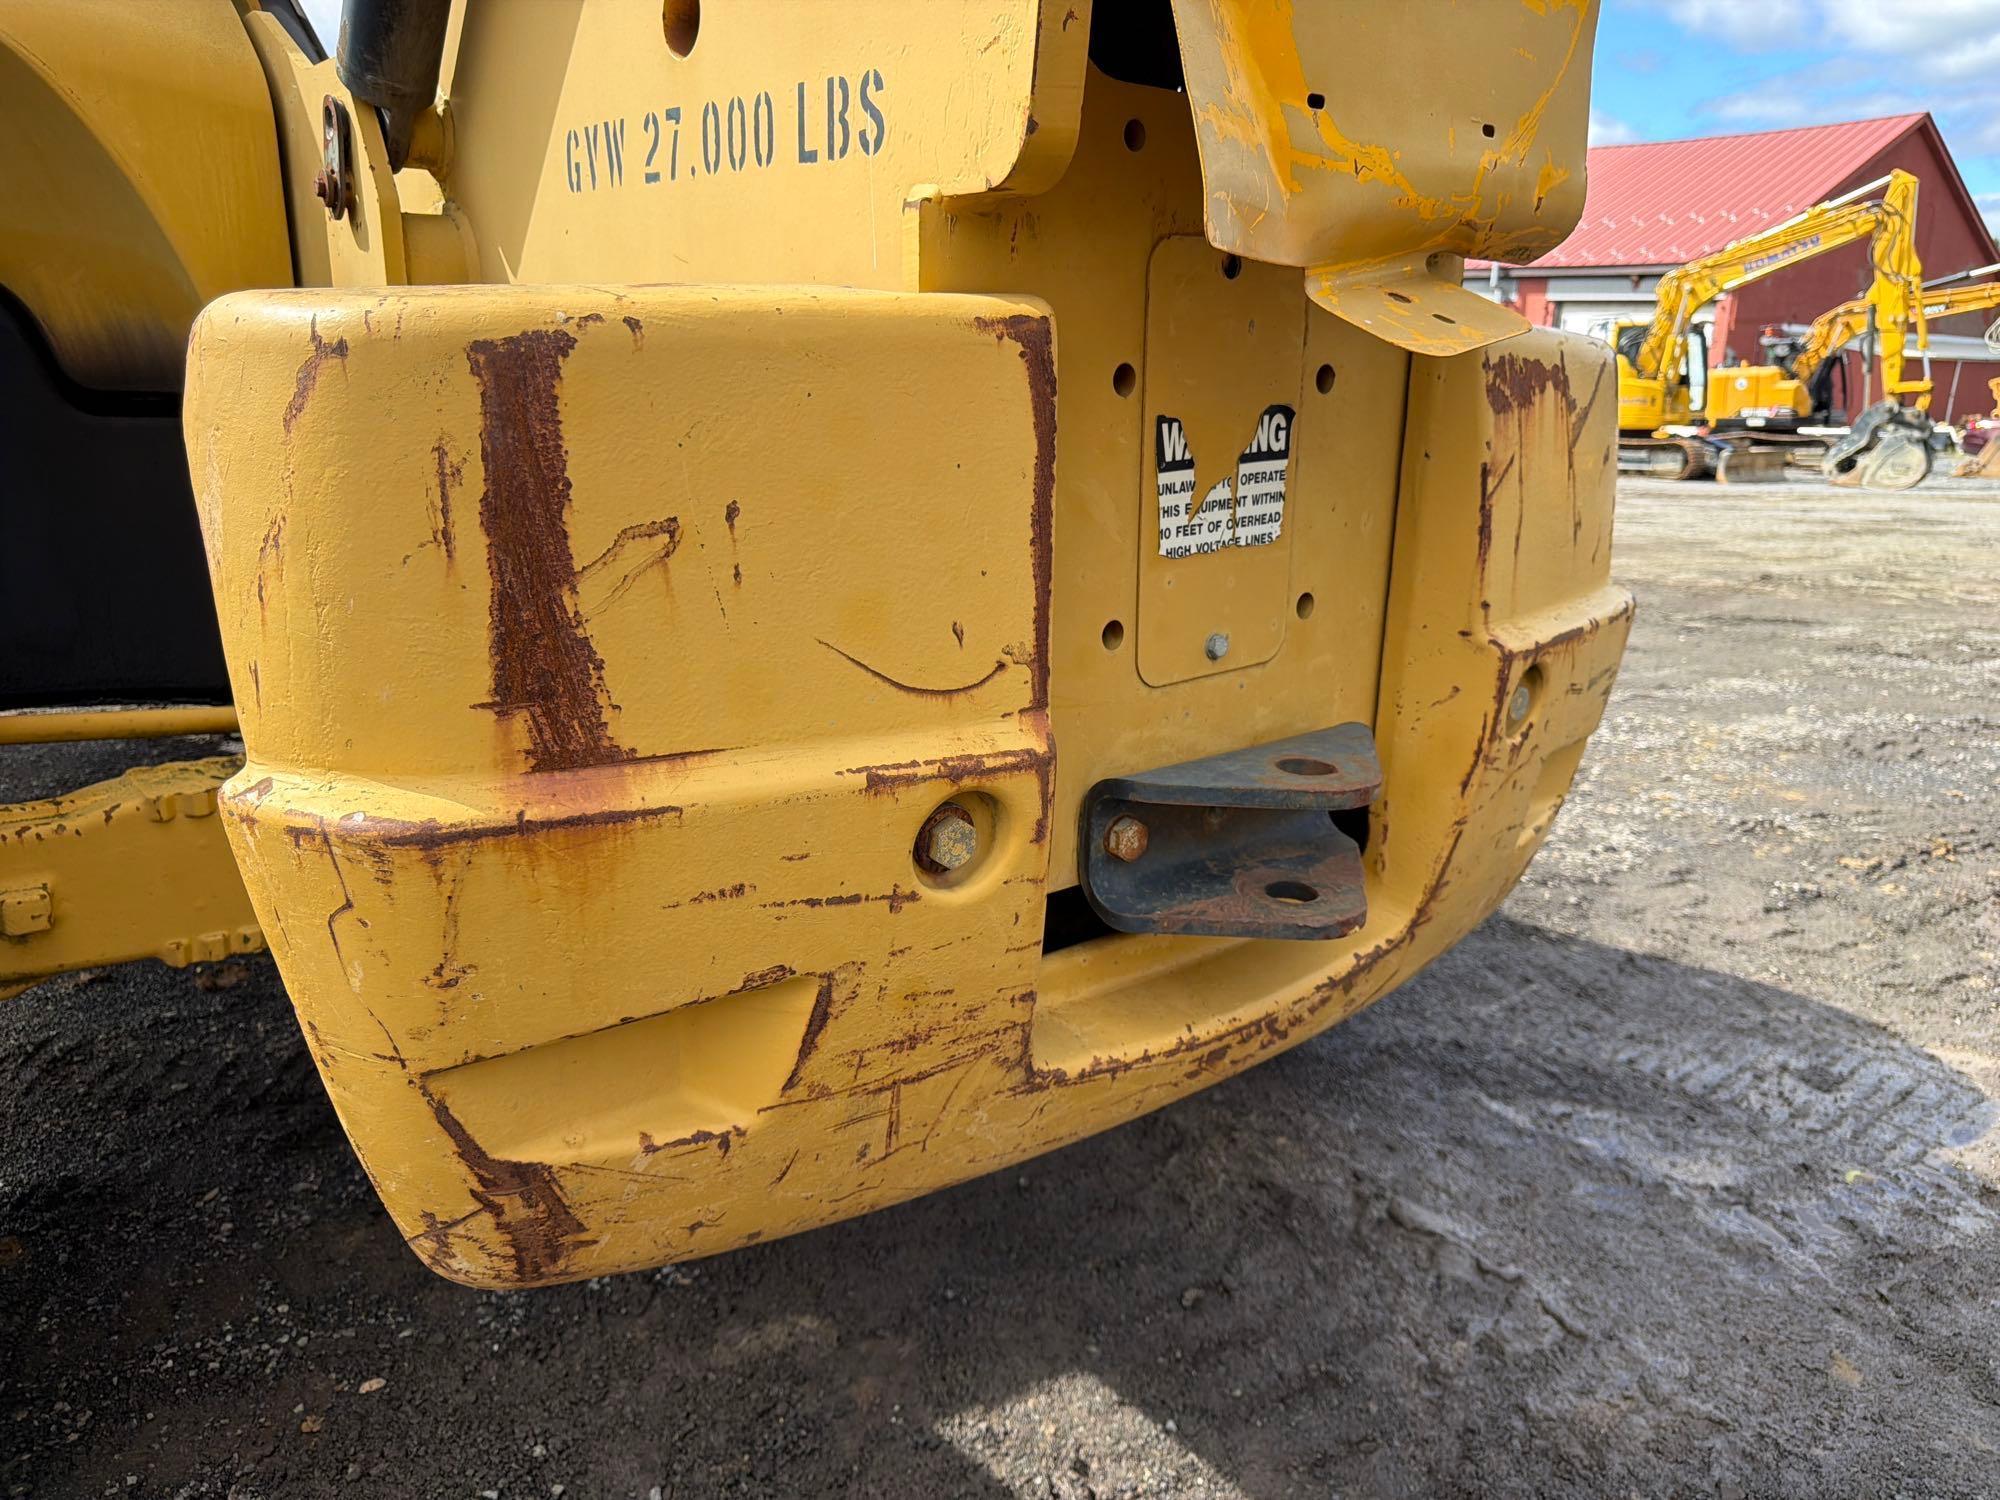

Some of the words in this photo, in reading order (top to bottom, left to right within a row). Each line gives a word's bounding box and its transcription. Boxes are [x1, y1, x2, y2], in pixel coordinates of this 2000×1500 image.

[566, 118, 625, 193] GVW
[643, 90, 774, 184] 27.000
[797, 68, 886, 164] LBS
[1240, 469, 1286, 486] OPERATE
[1161, 504, 1181, 519] HIS
[1185, 495, 1248, 515] EUIPMENT
[1252, 490, 1286, 506] WITHIN
[1159, 527, 1171, 540] 10
[1176, 523, 1203, 538] FEET
[1207, 520, 1222, 533] OF
[1226, 511, 1281, 530] OVERHEAD
[1166, 544, 1191, 558] HIGH
[1245, 532, 1273, 546] LINES
